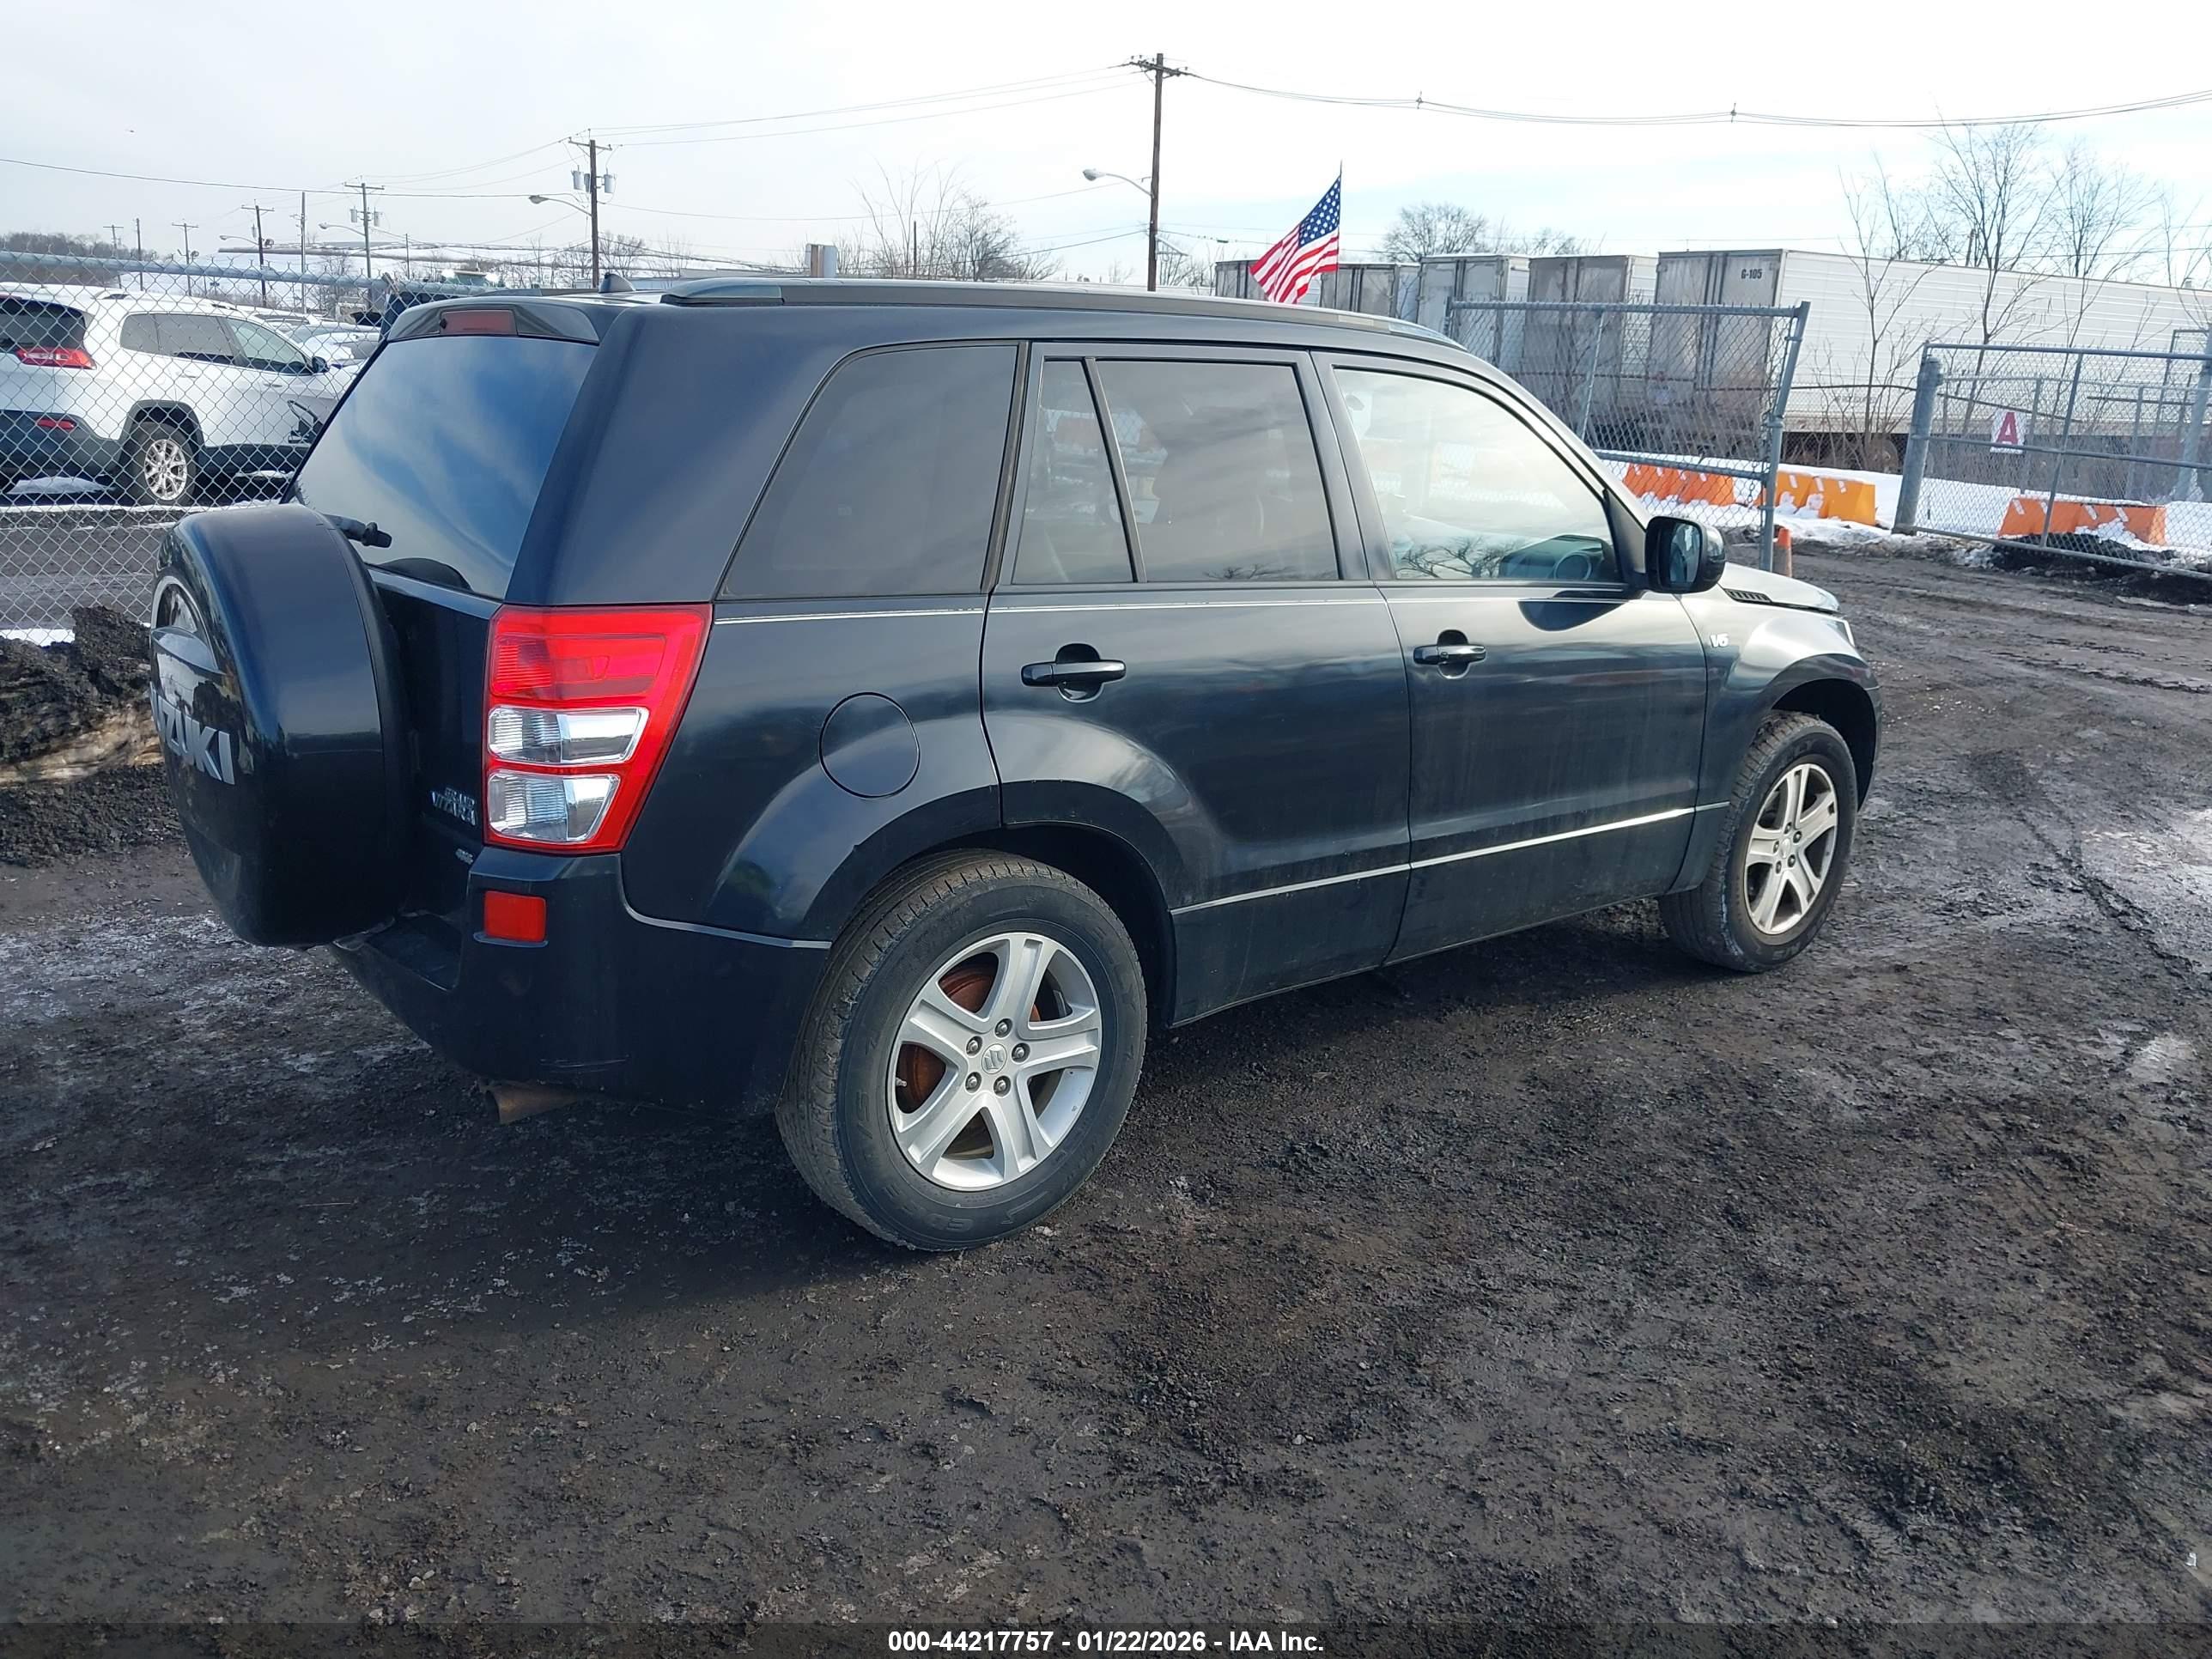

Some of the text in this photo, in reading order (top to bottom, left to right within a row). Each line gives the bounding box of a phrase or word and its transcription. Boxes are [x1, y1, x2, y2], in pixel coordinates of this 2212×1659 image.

[1741, 268, 1763, 280] G-105
[1996, 411, 2019, 446] A
[1709, 633, 1729, 648] V6
[149, 681, 236, 786] UZUKI
